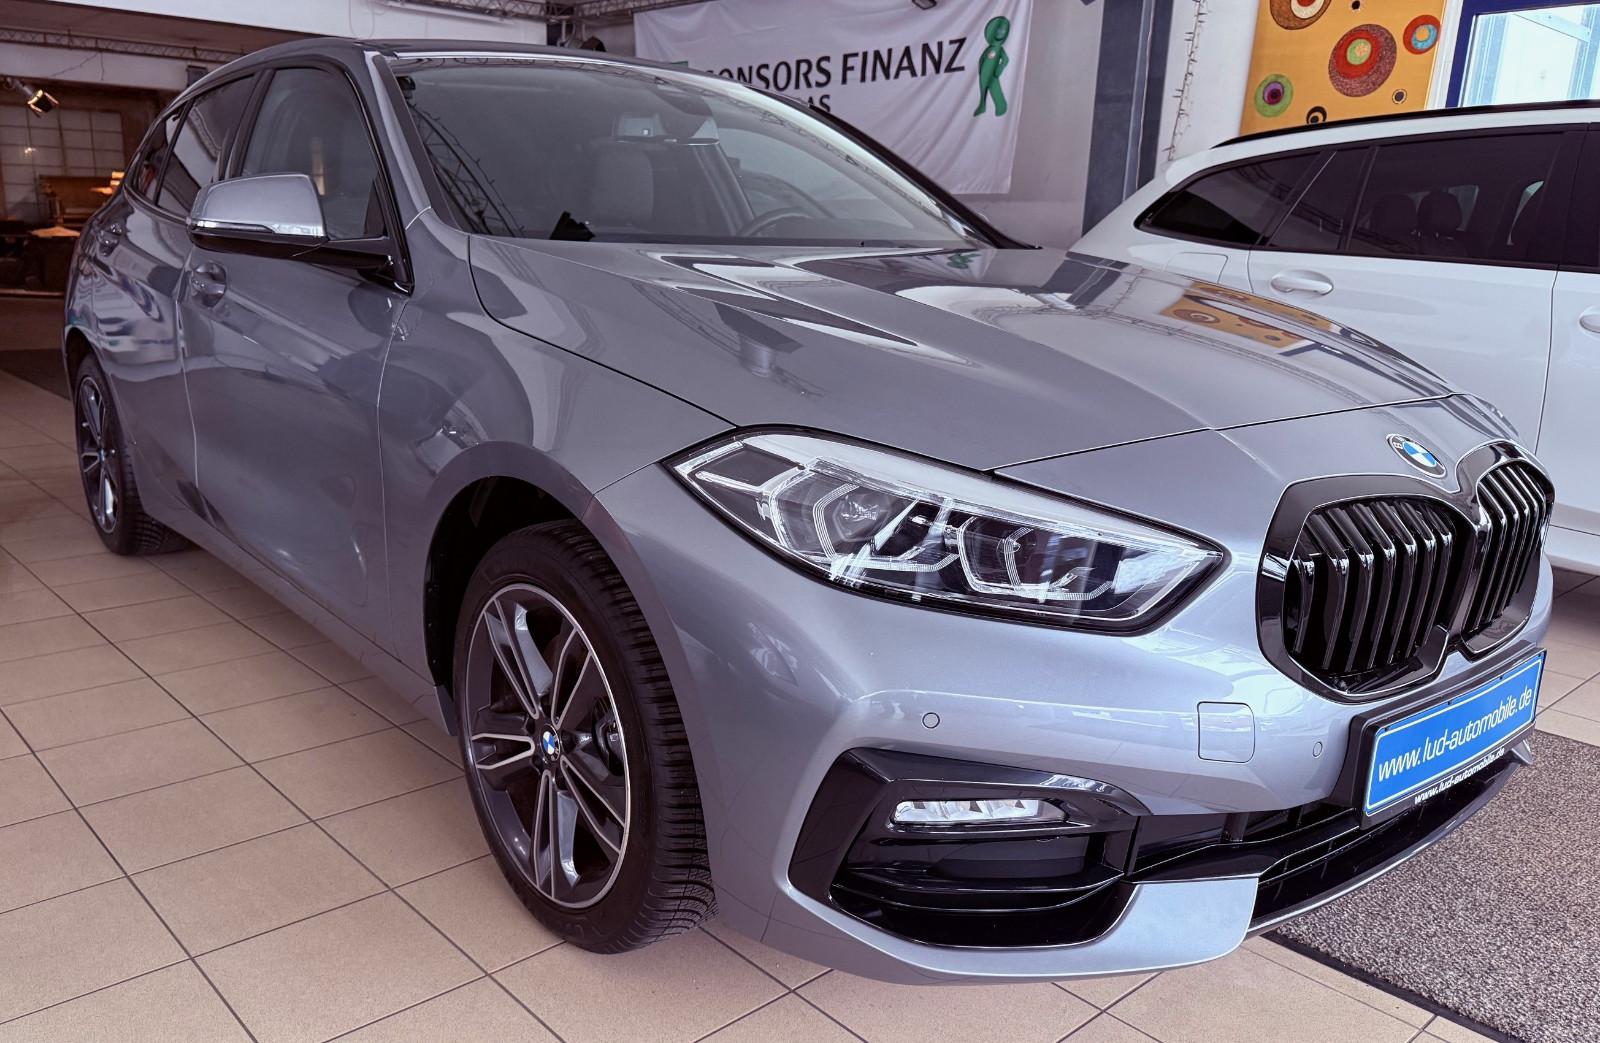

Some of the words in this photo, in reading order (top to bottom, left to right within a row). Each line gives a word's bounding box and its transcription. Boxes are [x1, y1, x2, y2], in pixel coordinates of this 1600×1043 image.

[705, 56, 831, 91] NSORS
[842, 37, 967, 84] FINANZ
[1378, 686, 1532, 782] www.lud-automobile.de
[1414, 748, 1504, 804] www.lud-automobile.de
